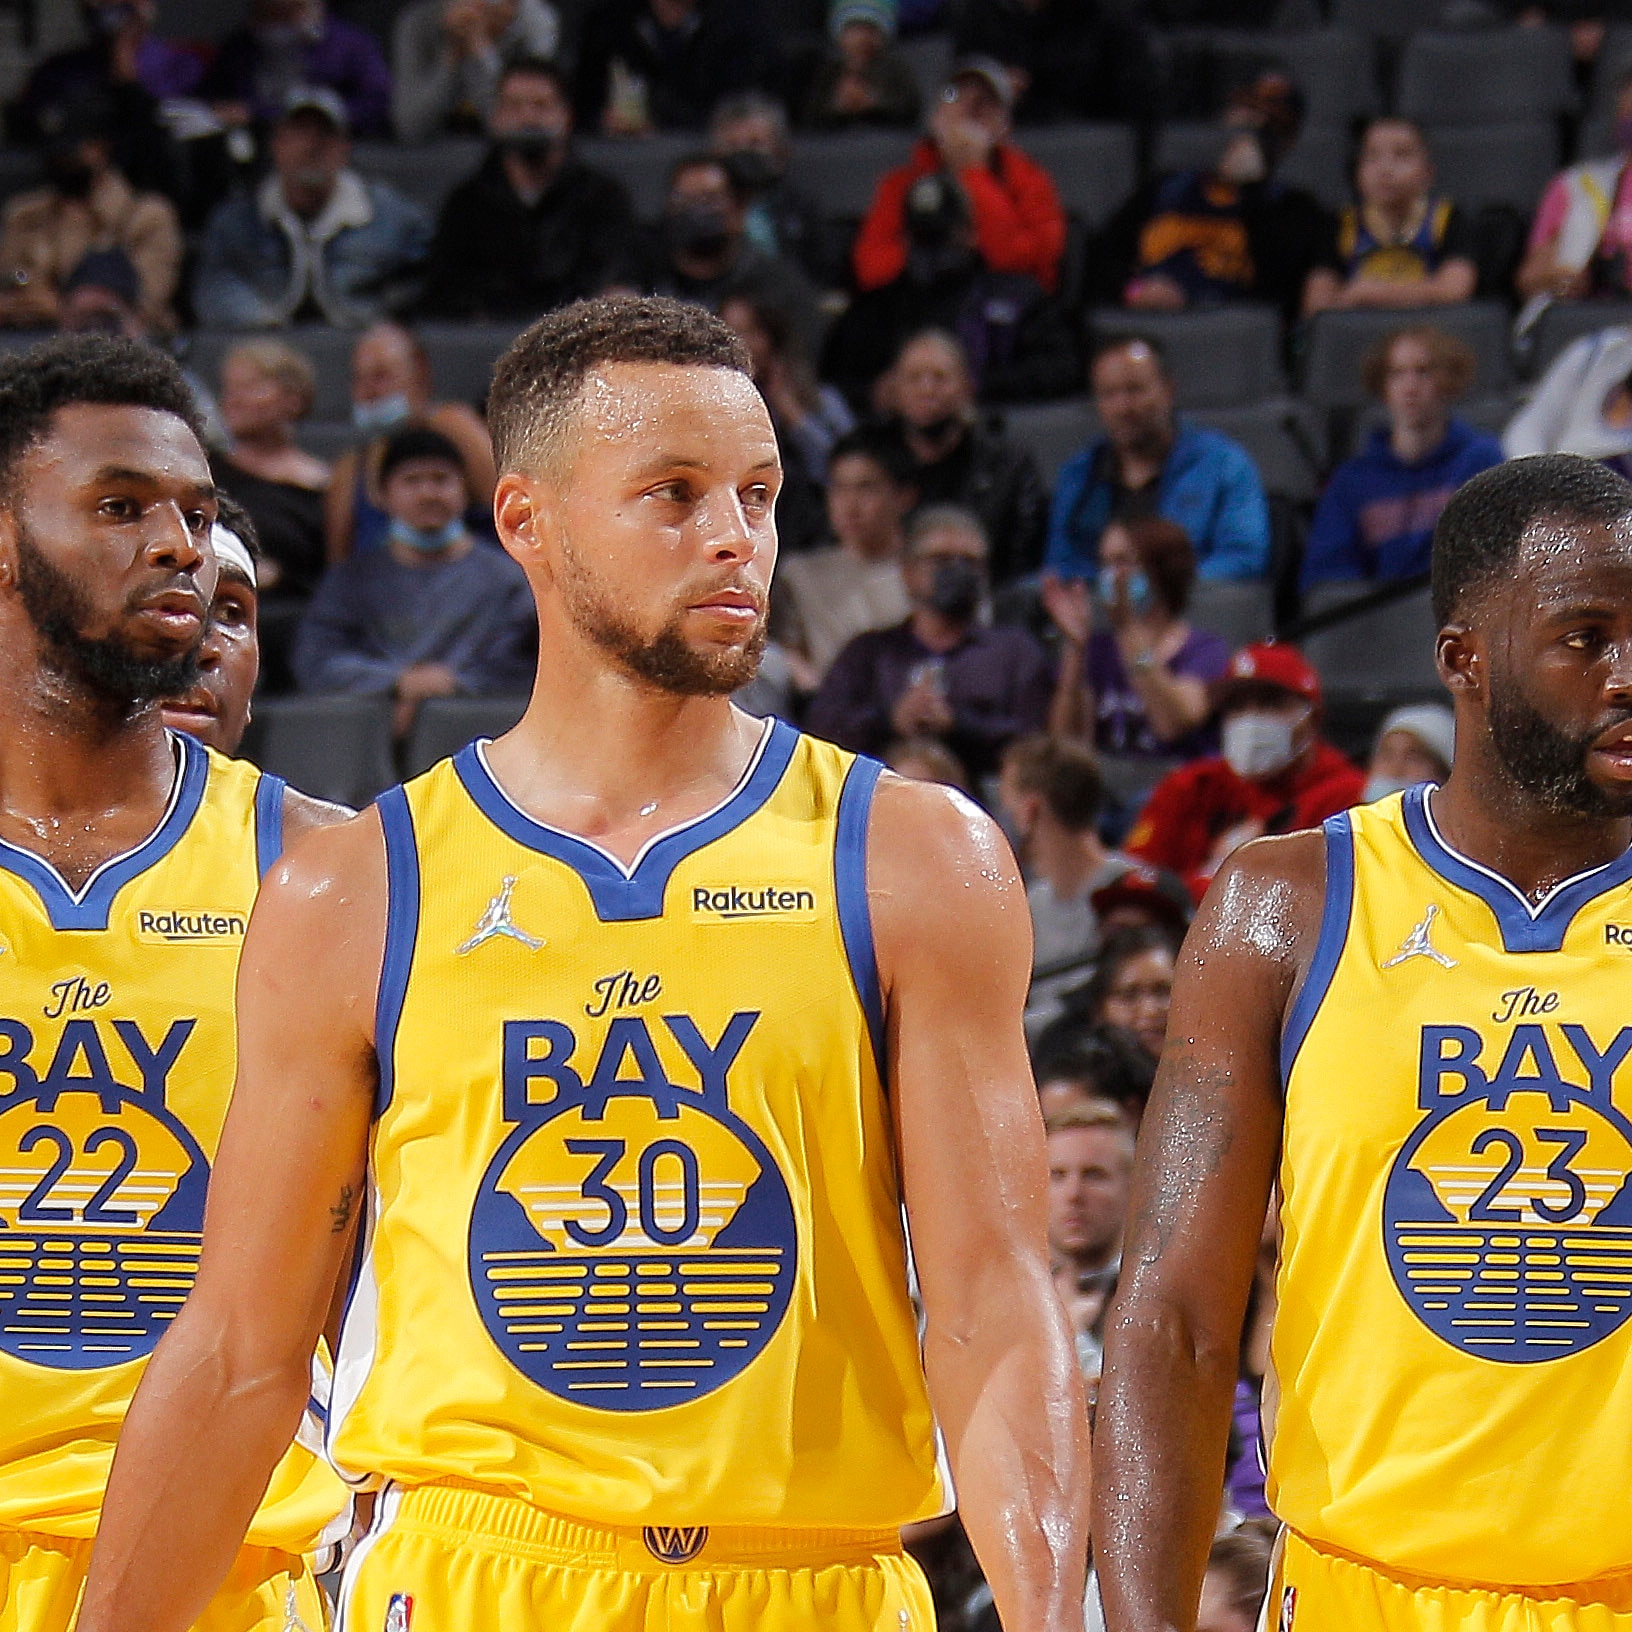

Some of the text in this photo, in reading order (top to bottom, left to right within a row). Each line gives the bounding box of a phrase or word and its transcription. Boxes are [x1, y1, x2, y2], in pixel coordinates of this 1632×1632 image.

[692, 884, 815, 912] Rakuten
[139, 910, 245, 937] Rakuten
[42, 976, 112, 1019] The
[584, 968, 663, 1018] The
[1491, 986, 1561, 1024] The
[501, 1010, 763, 1123] BAY
[17, 1124, 139, 1223] 22
[562, 1138, 700, 1248] 30
[1468, 1128, 1587, 1223] 23
